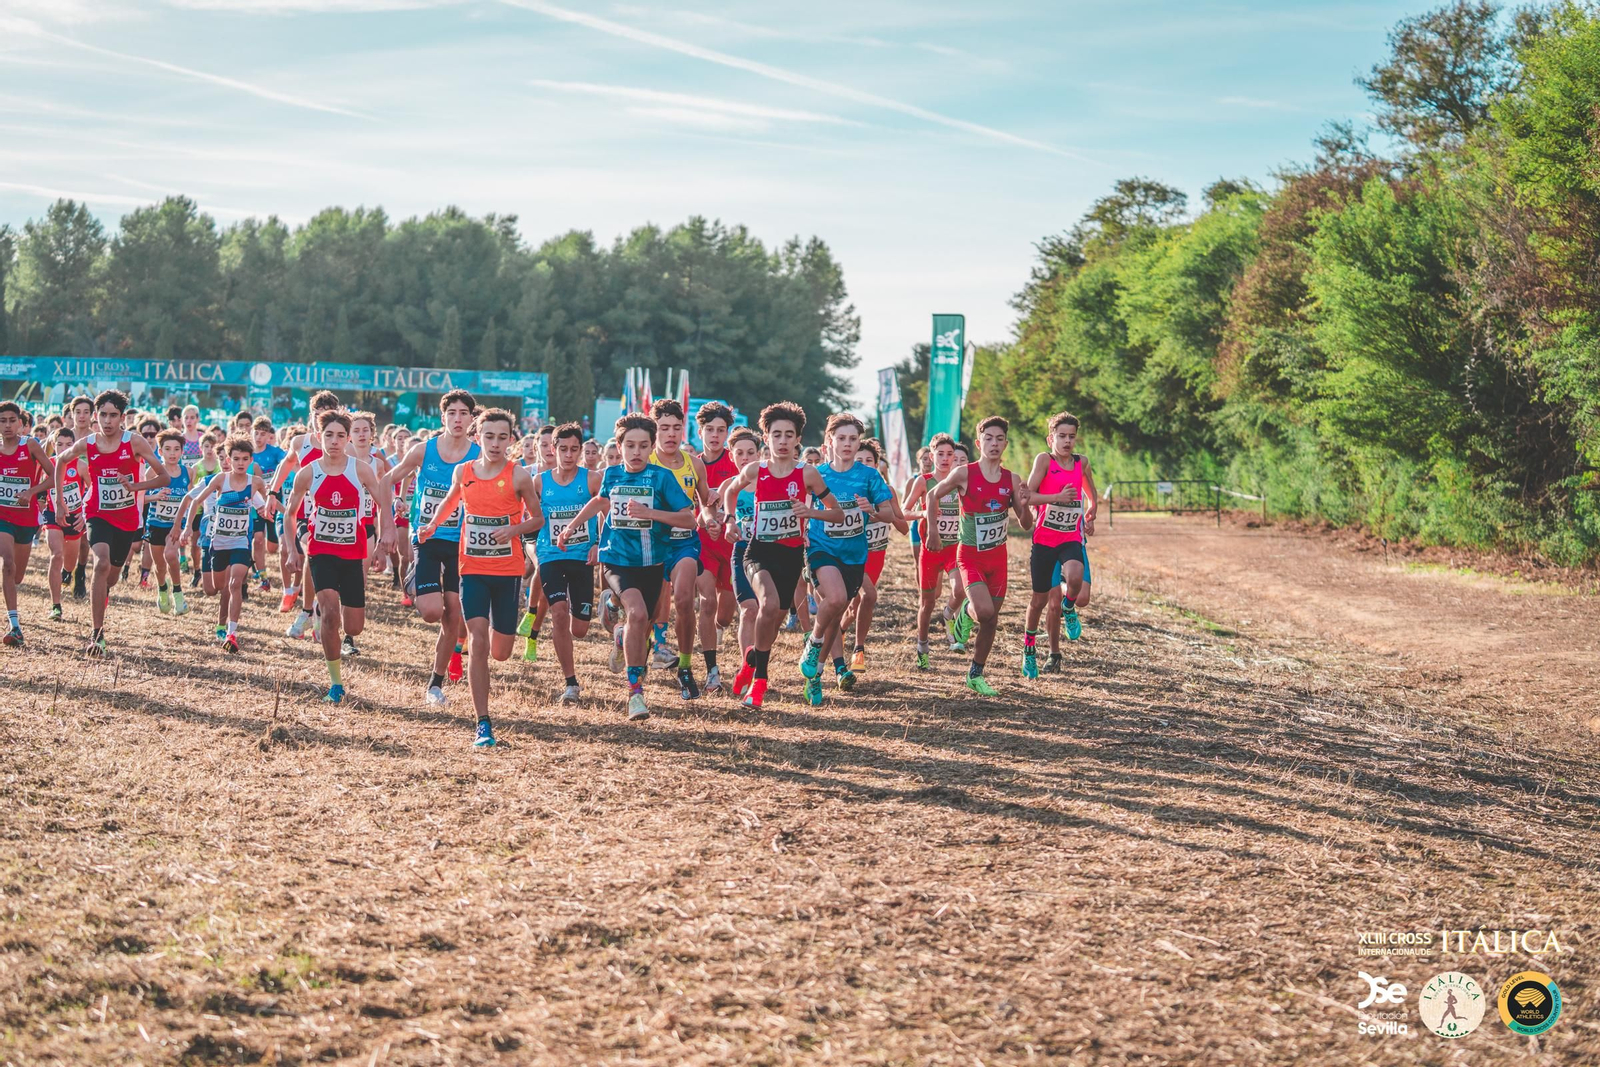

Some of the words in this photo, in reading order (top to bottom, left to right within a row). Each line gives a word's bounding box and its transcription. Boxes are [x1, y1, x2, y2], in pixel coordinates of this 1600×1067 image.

[96, 362, 130, 371] CROSS
[144, 359, 225, 381] ITÁLICA
[326, 368, 360, 379] CROSS
[373, 367, 453, 390] ITÁLICA
[160, 504, 180, 516] 797
[1047, 509, 1079, 524] 5819
[218, 517, 247, 530] 8017
[319, 520, 354, 535] 7953
[761, 514, 798, 532] 7948
[469, 530, 498, 546] 588
